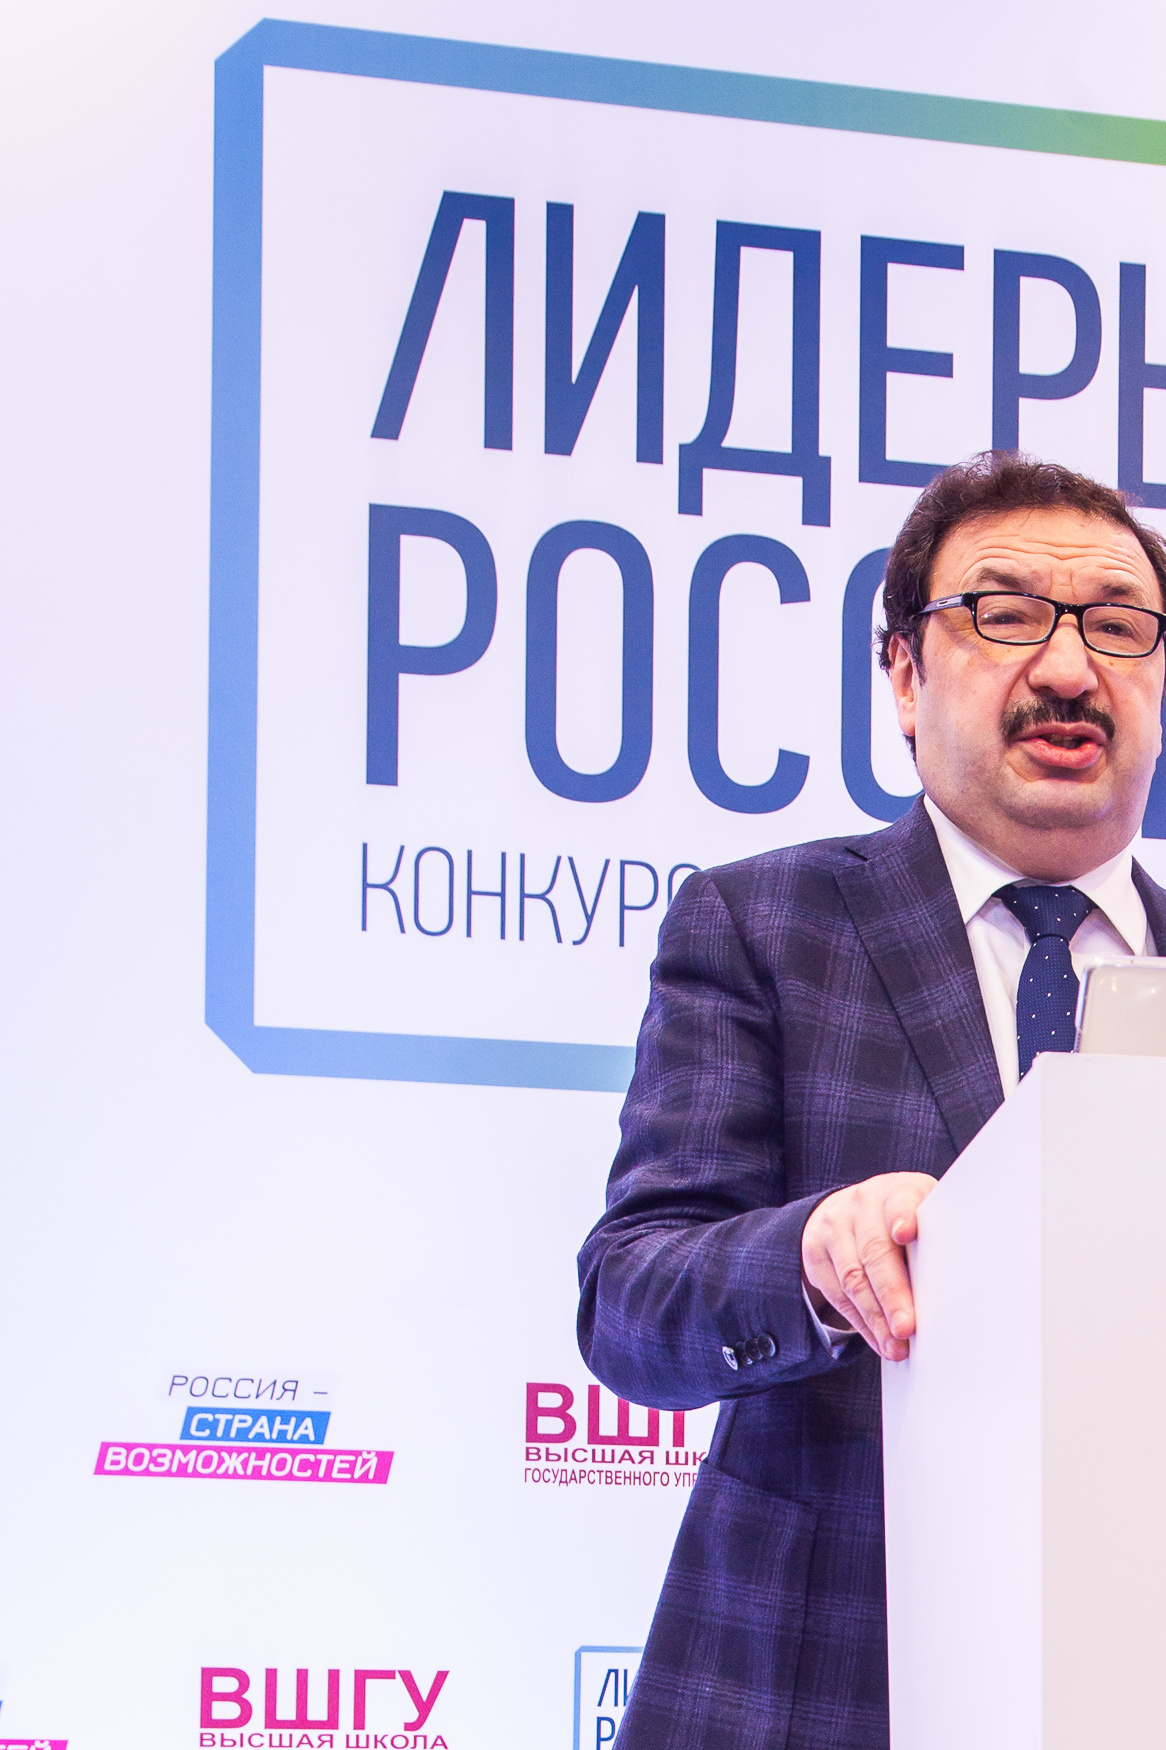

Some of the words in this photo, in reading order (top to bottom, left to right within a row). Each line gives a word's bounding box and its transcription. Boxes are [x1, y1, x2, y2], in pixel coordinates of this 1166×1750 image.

[169, 1375, 299, 1401] РОССИЯ
[190, 1413, 316, 1441] СТРАНА
[103, 1447, 378, 1480] ВОЗМОЖНОСТЕЙ
[525, 1447, 655, 1465] ВЫСШАЯ
[524, 1468, 670, 1487] ГОСУДАРСТВЕННОГО
[200, 1667, 450, 1732] ВШГУ
[199, 1732, 334, 1749] ВЫСШАЯ
[346, 1734, 449, 1750] ШКОЛА
